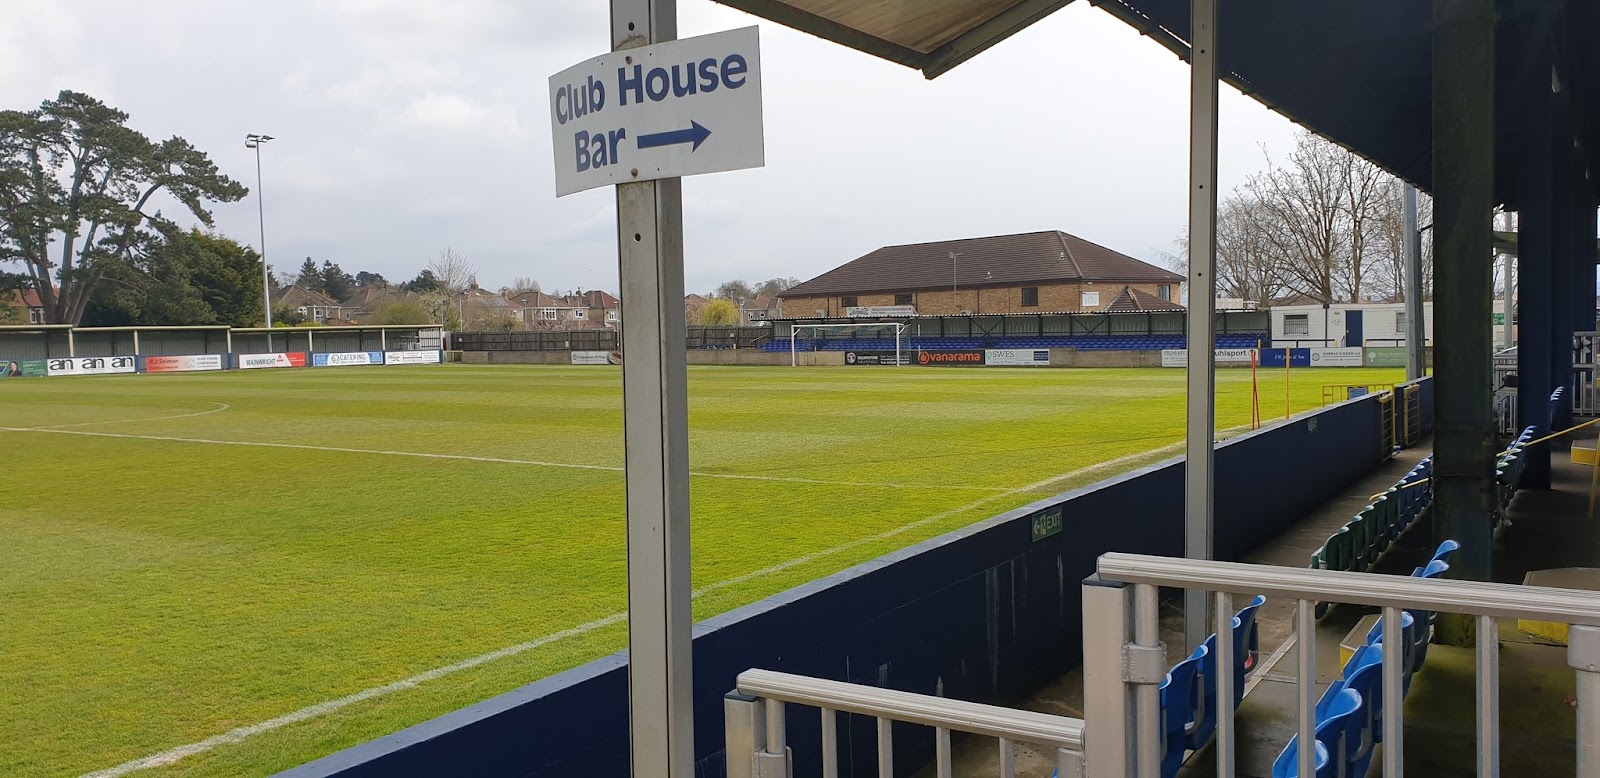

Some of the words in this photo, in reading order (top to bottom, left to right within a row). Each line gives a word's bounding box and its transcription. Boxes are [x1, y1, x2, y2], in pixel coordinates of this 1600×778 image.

[555, 75, 605, 125] Club
[617, 53, 748, 107] House
[574, 127, 626, 173] Bar
[340, 353, 366, 361] CATERING
[930, 353, 981, 362] vanarama
[1214, 349, 1246, 358] uhlsport
[1046, 511, 1062, 530] EXIT
